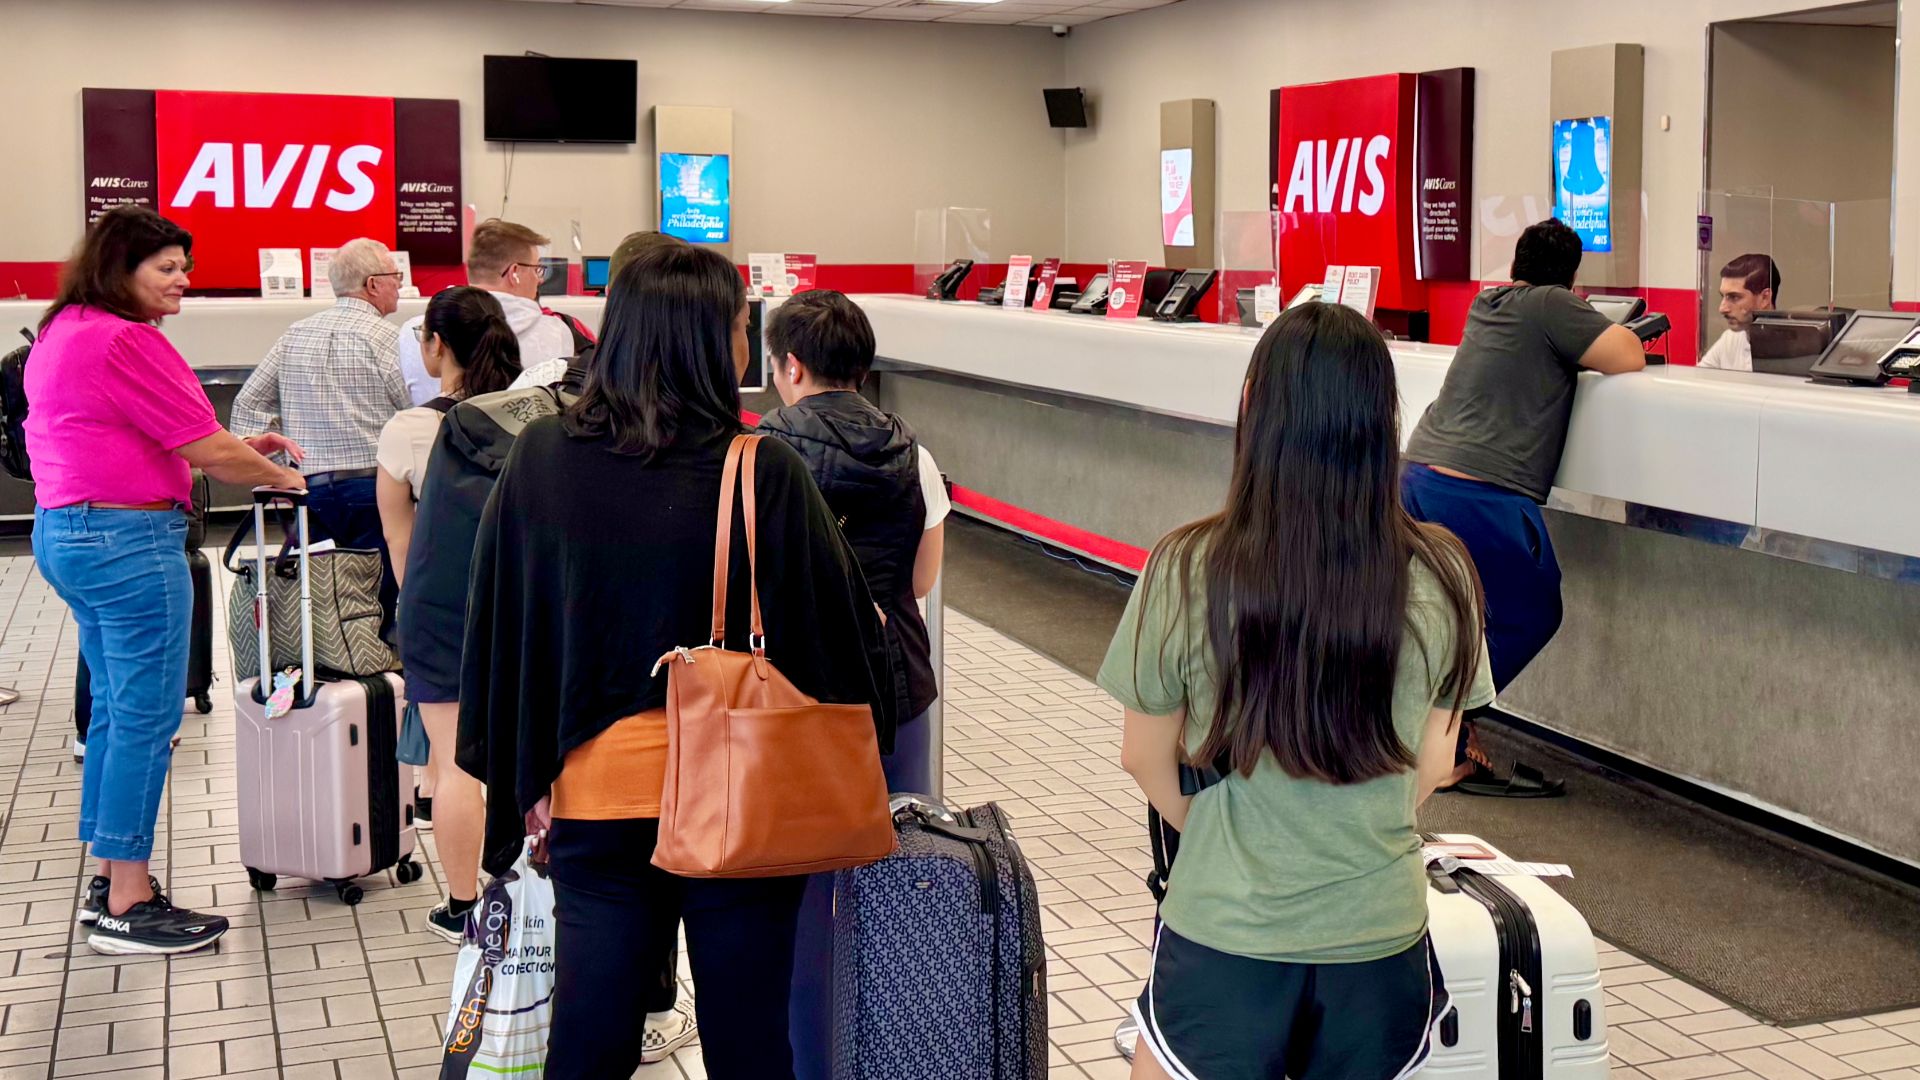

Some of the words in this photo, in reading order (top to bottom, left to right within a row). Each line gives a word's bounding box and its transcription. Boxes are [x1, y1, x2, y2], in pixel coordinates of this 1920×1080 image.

[171, 142, 383, 212] AVIS
[1284, 135, 1391, 216] AVIS
[667, 217, 724, 230] Philadelphia
[1592, 234, 1608, 245] AVIS
[97, 915, 131, 933] HOKA
